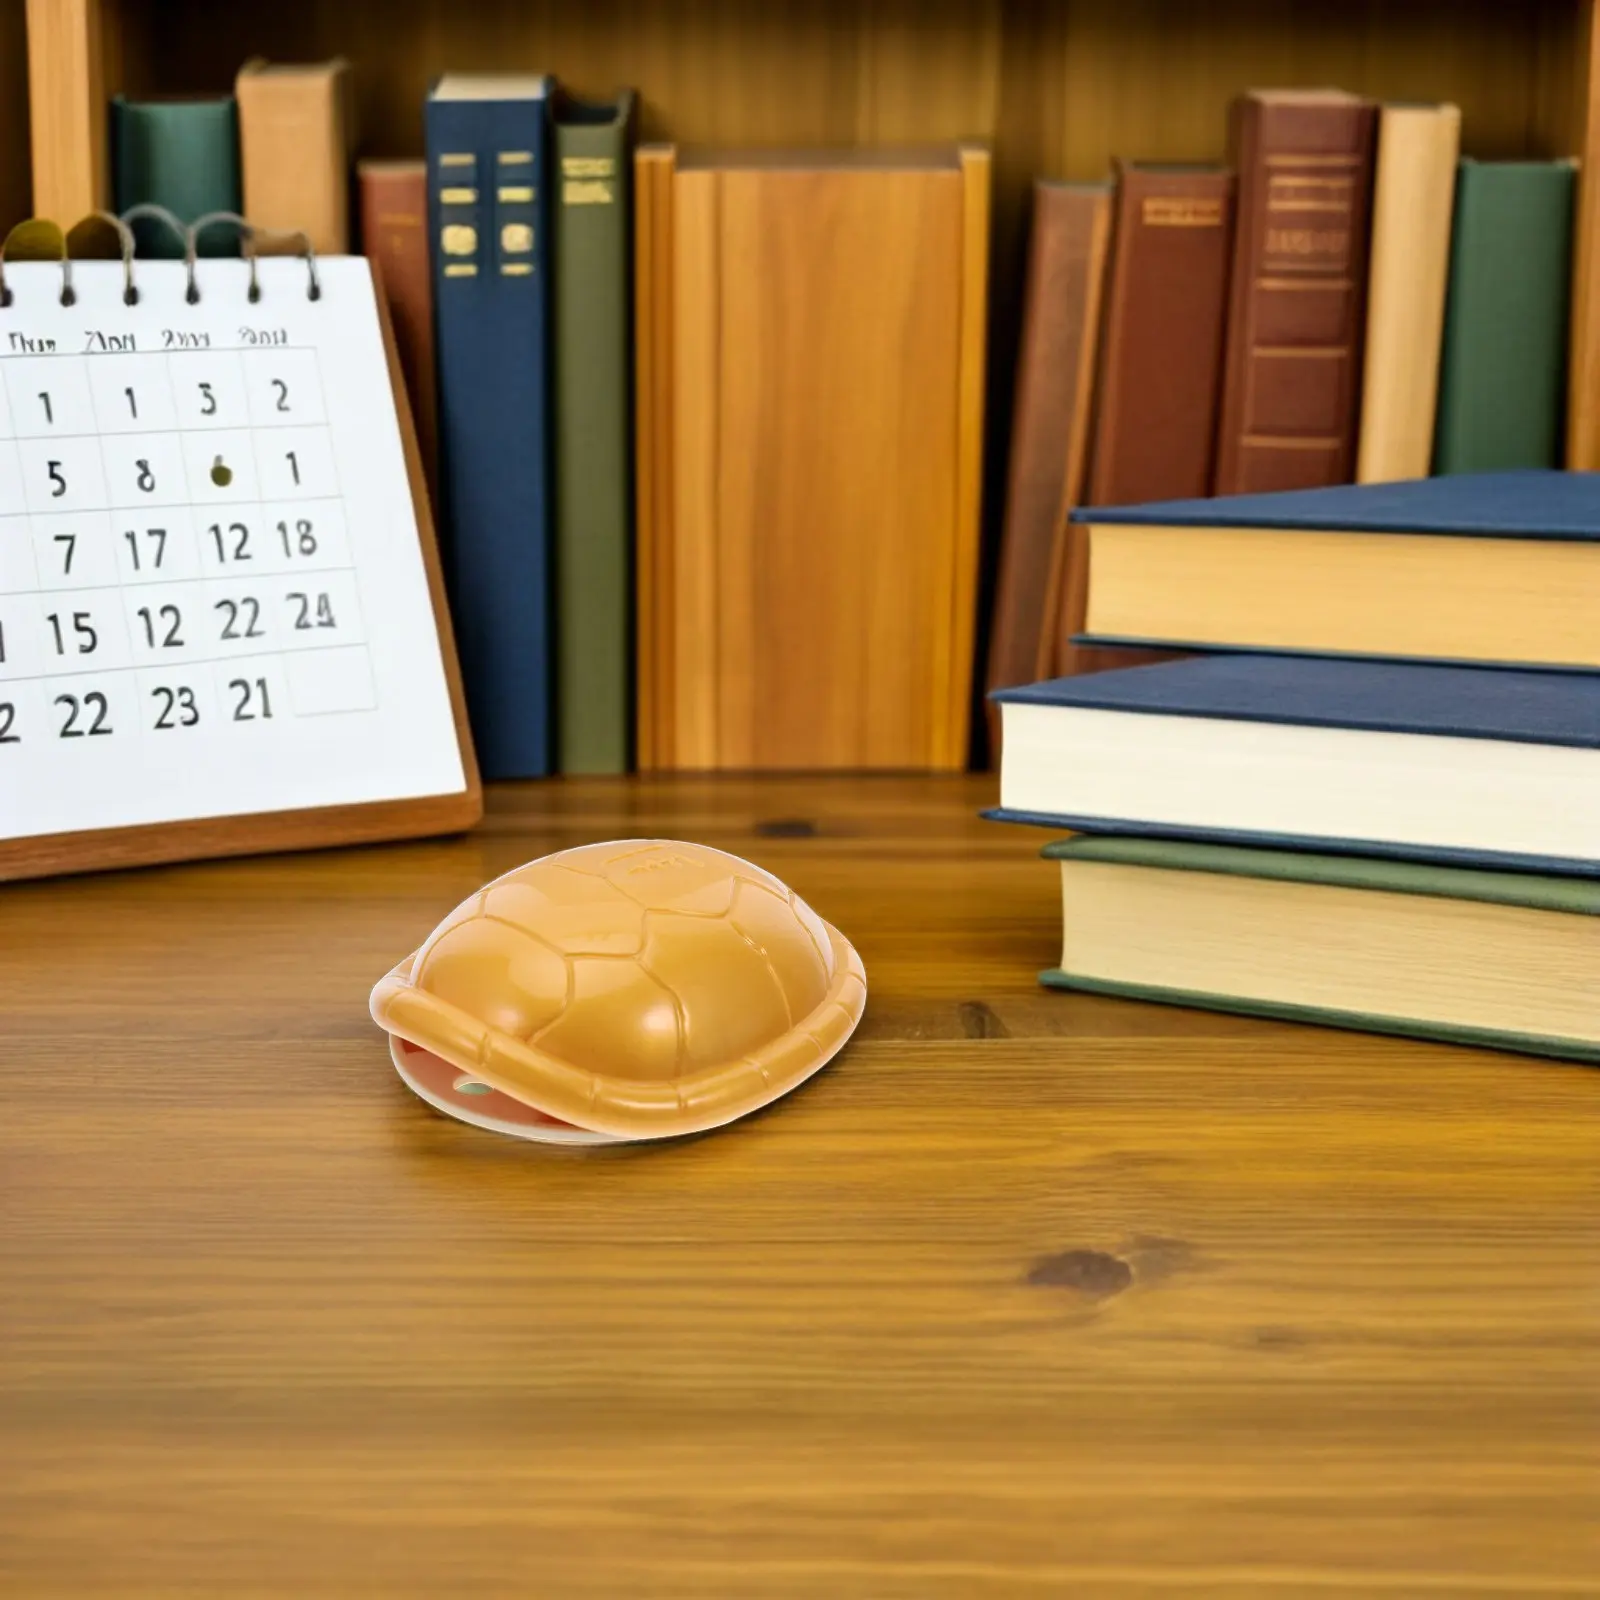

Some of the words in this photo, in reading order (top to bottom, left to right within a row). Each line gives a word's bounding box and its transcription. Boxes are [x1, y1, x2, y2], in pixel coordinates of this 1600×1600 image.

[124, 387, 137, 419] 1
[271, 378, 290, 412] 2
[47, 460, 67, 498] 5
[286, 451, 300, 485] 1
[53, 534, 76, 575] 7
[125, 528, 167, 570] 17
[208, 522, 252, 563] 12
[46, 612, 98, 655] 15
[137, 604, 185, 649] 12
[214, 596, 264, 641] 22
[53, 691, 113, 738] 22
[151, 685, 200, 730] 23
[228, 677, 273, 722] 21
